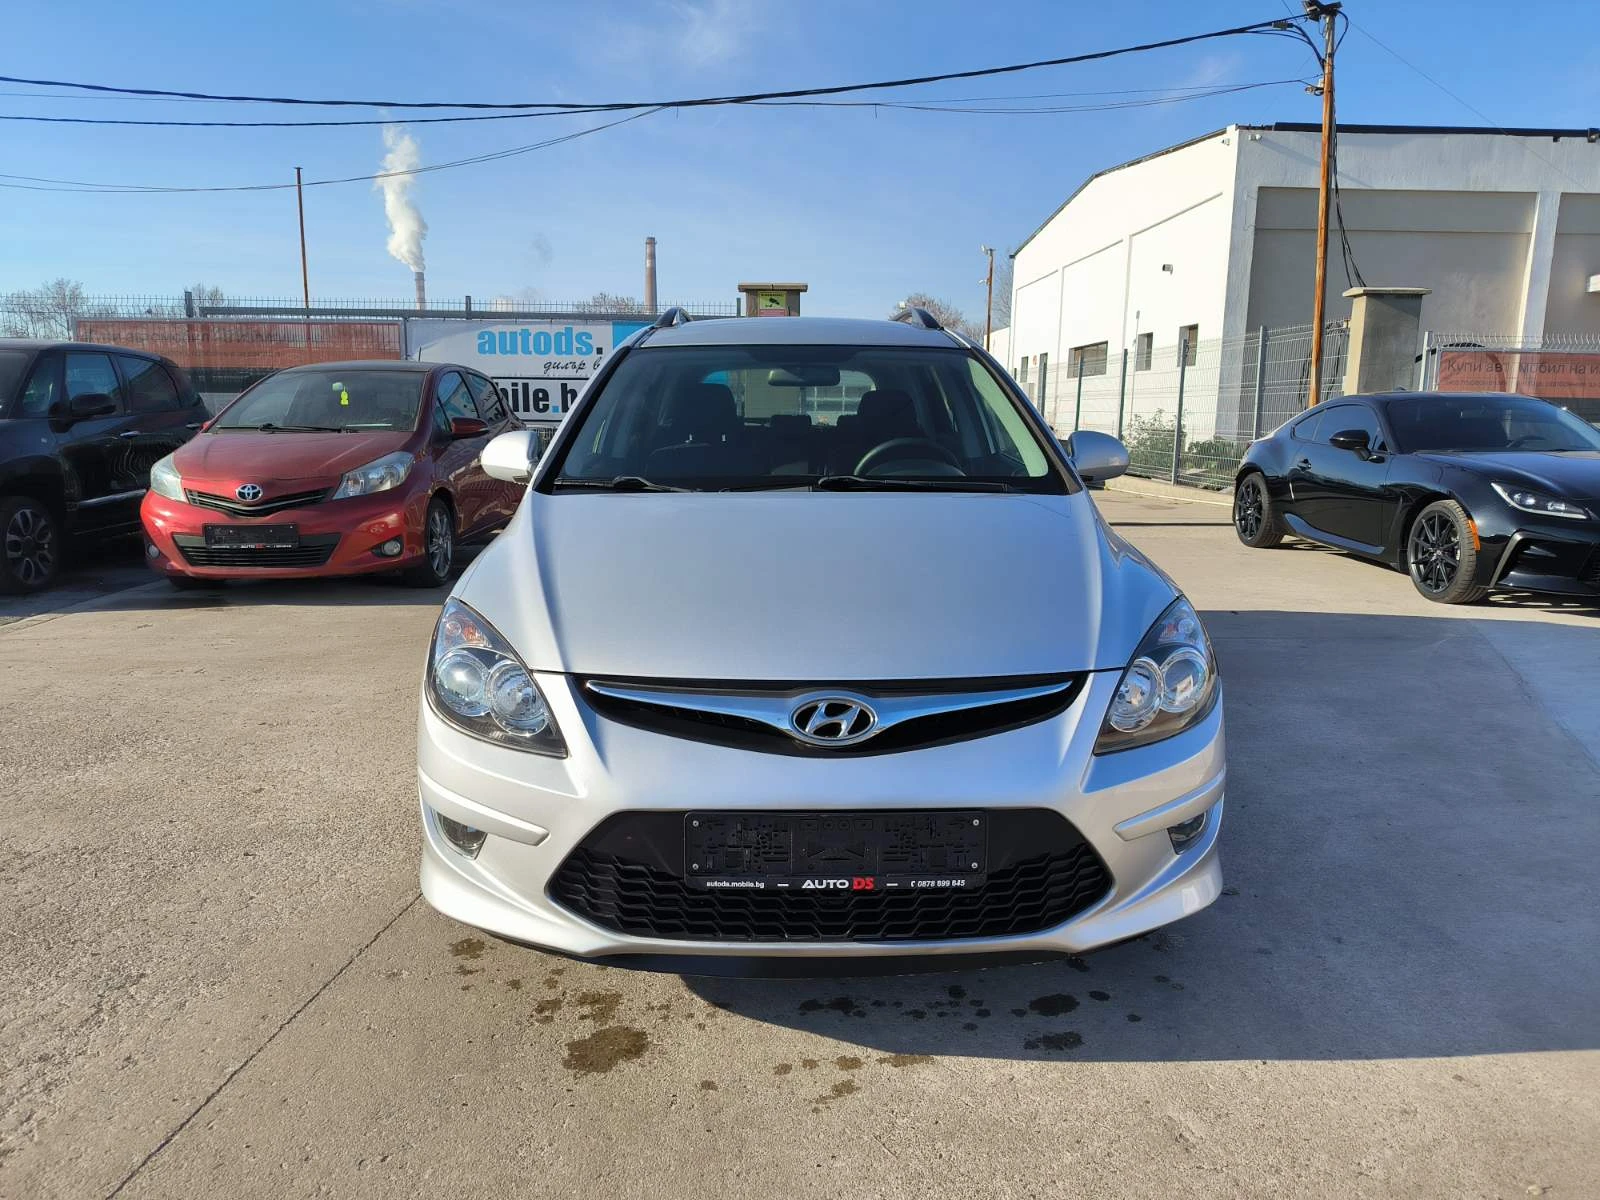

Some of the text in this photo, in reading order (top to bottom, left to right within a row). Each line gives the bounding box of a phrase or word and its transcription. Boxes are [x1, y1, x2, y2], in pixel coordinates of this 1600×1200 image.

[543, 359, 586, 375] дилър
[1447, 359, 1482, 373] Купи
[1569, 363, 1586, 375] на
[801, 877, 875, 890] AUTO DS
